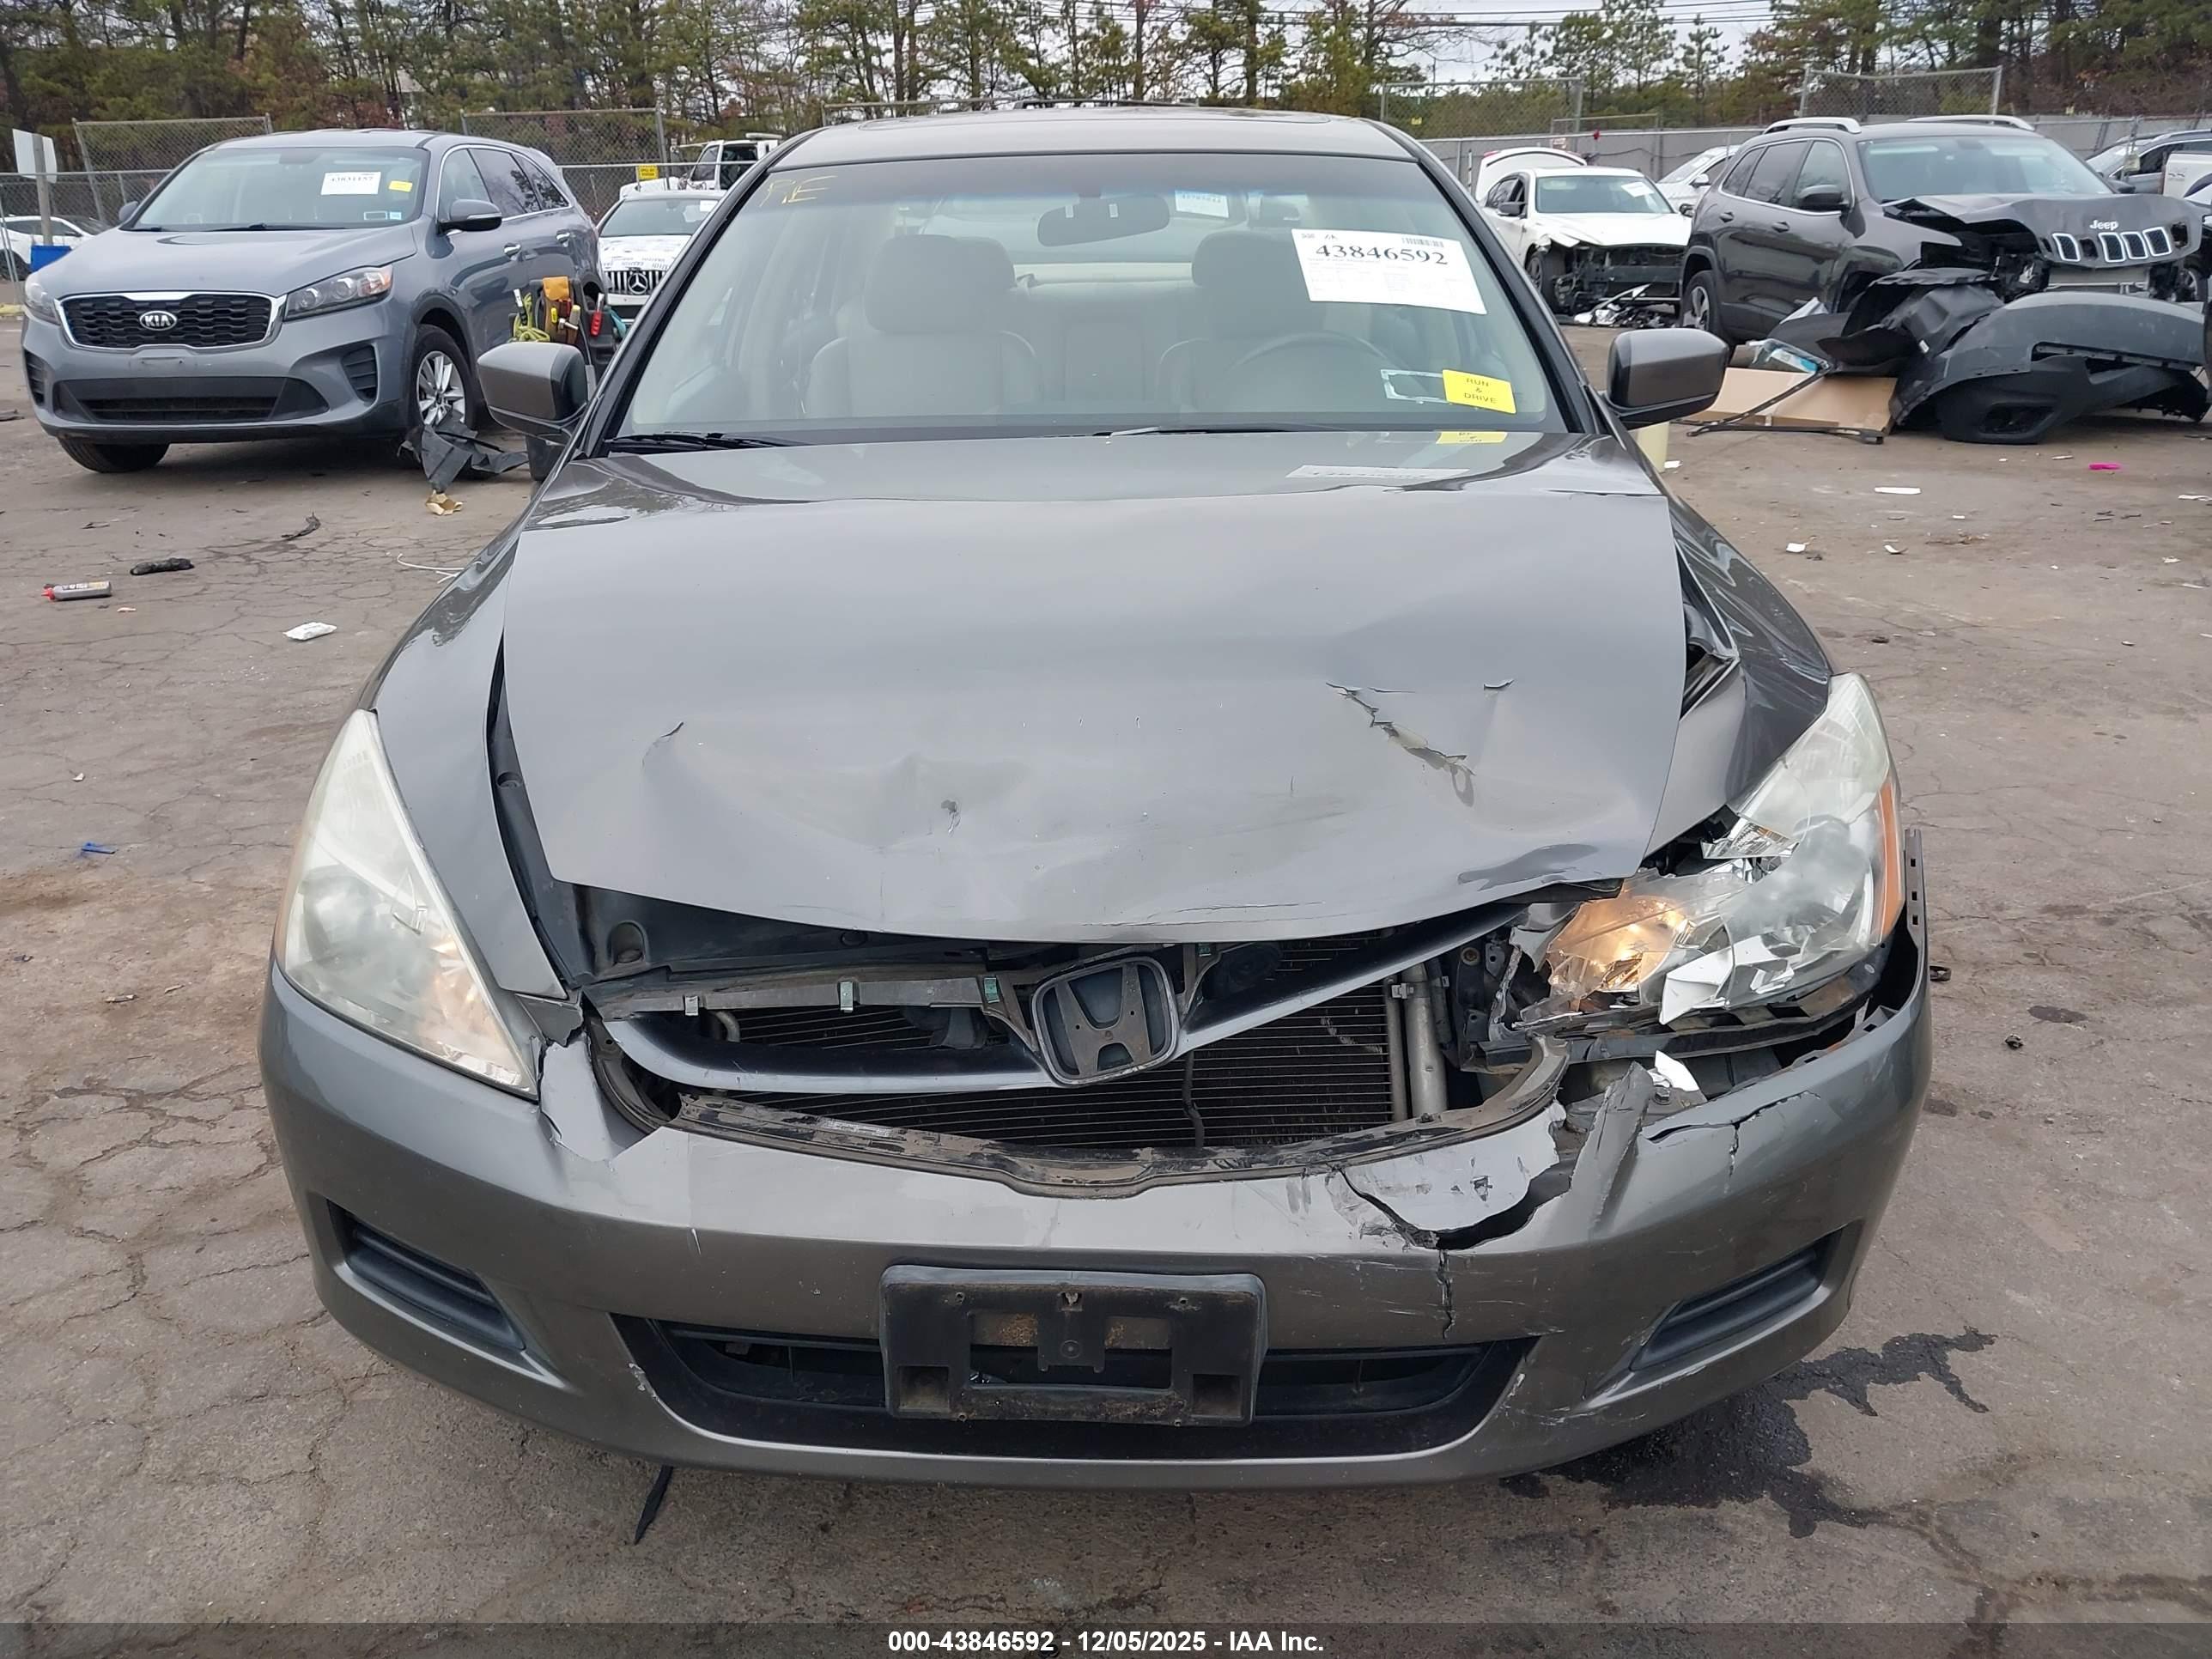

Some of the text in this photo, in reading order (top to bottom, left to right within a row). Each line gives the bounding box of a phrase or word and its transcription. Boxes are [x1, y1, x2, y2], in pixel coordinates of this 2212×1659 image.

[2089, 219, 2119, 231] Jeep
[1316, 244, 1449, 265] 43846592
[144, 314, 171, 326] KIA
[1466, 378, 1490, 387] RUN
[1463, 392, 1498, 404] DRIVE
